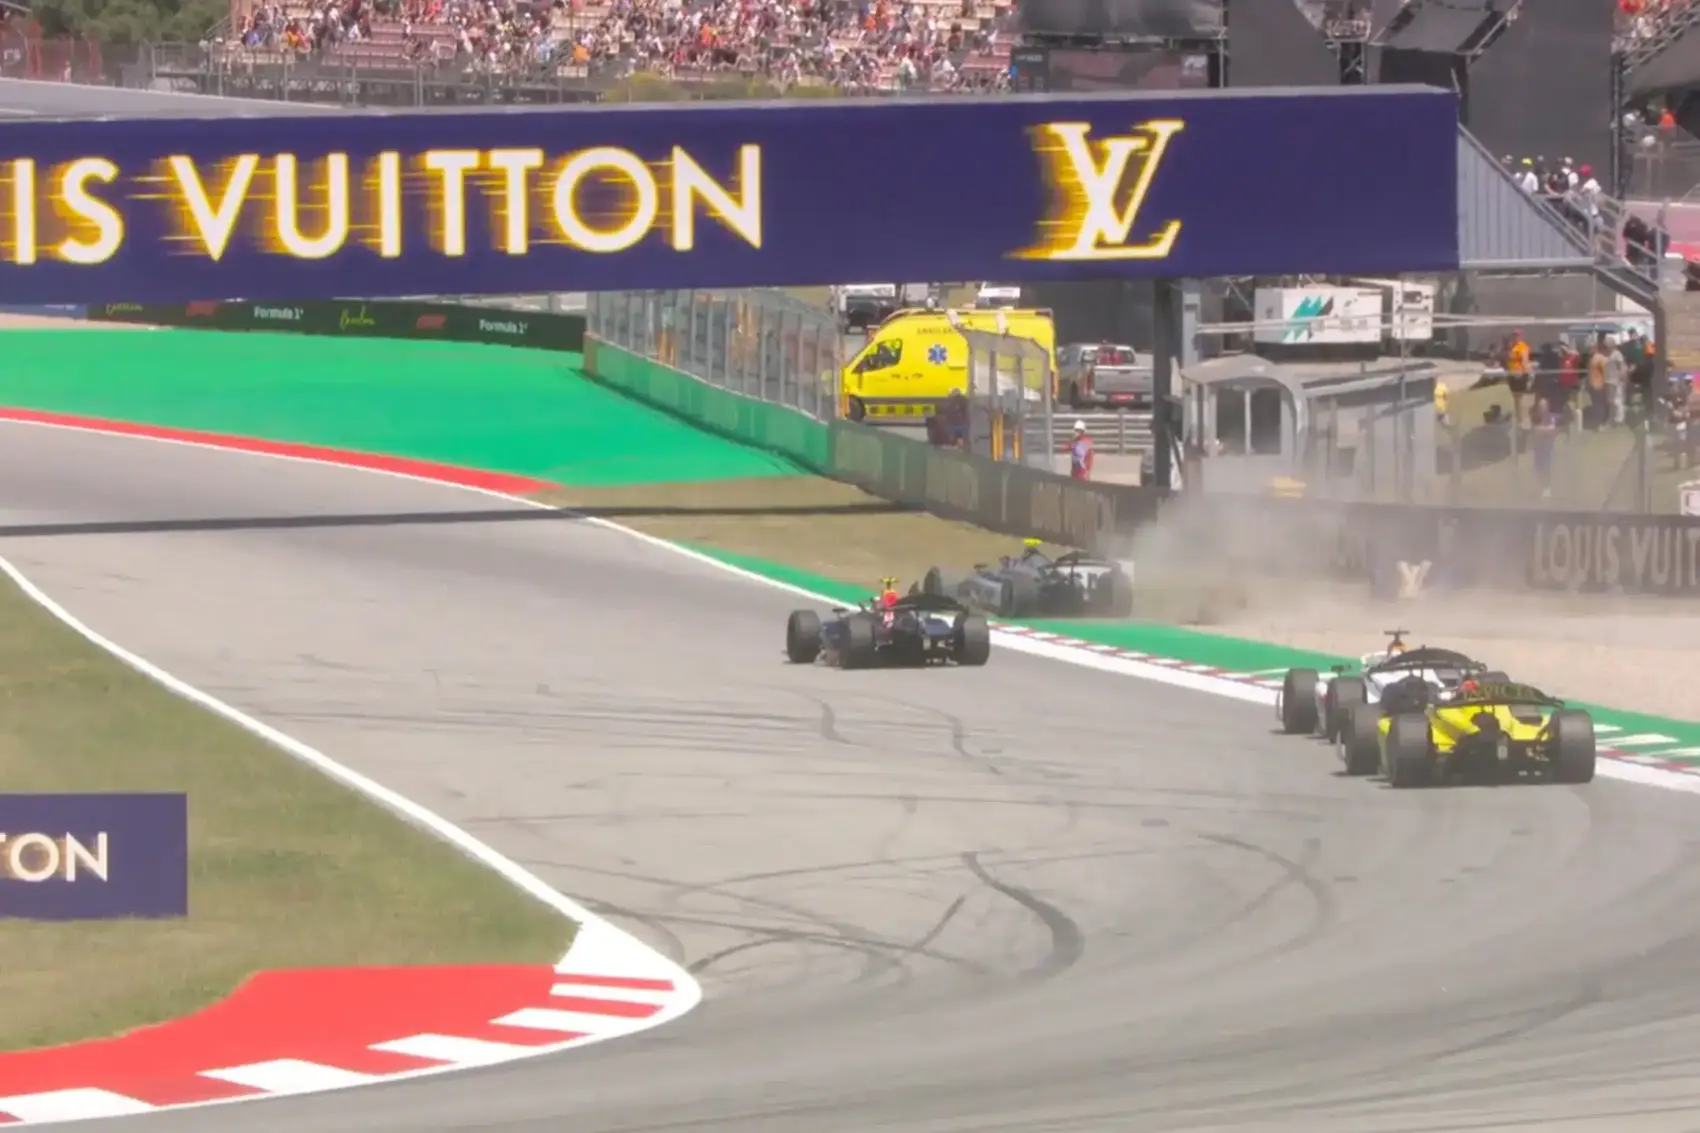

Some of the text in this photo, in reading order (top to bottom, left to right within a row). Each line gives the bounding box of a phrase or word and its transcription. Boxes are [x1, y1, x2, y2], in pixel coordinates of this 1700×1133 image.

[167, 143, 762, 261] VUITTON
[254, 306, 293, 319] Formula
[479, 319, 517, 333] Formula
[1533, 523, 1621, 585] LOUIS
